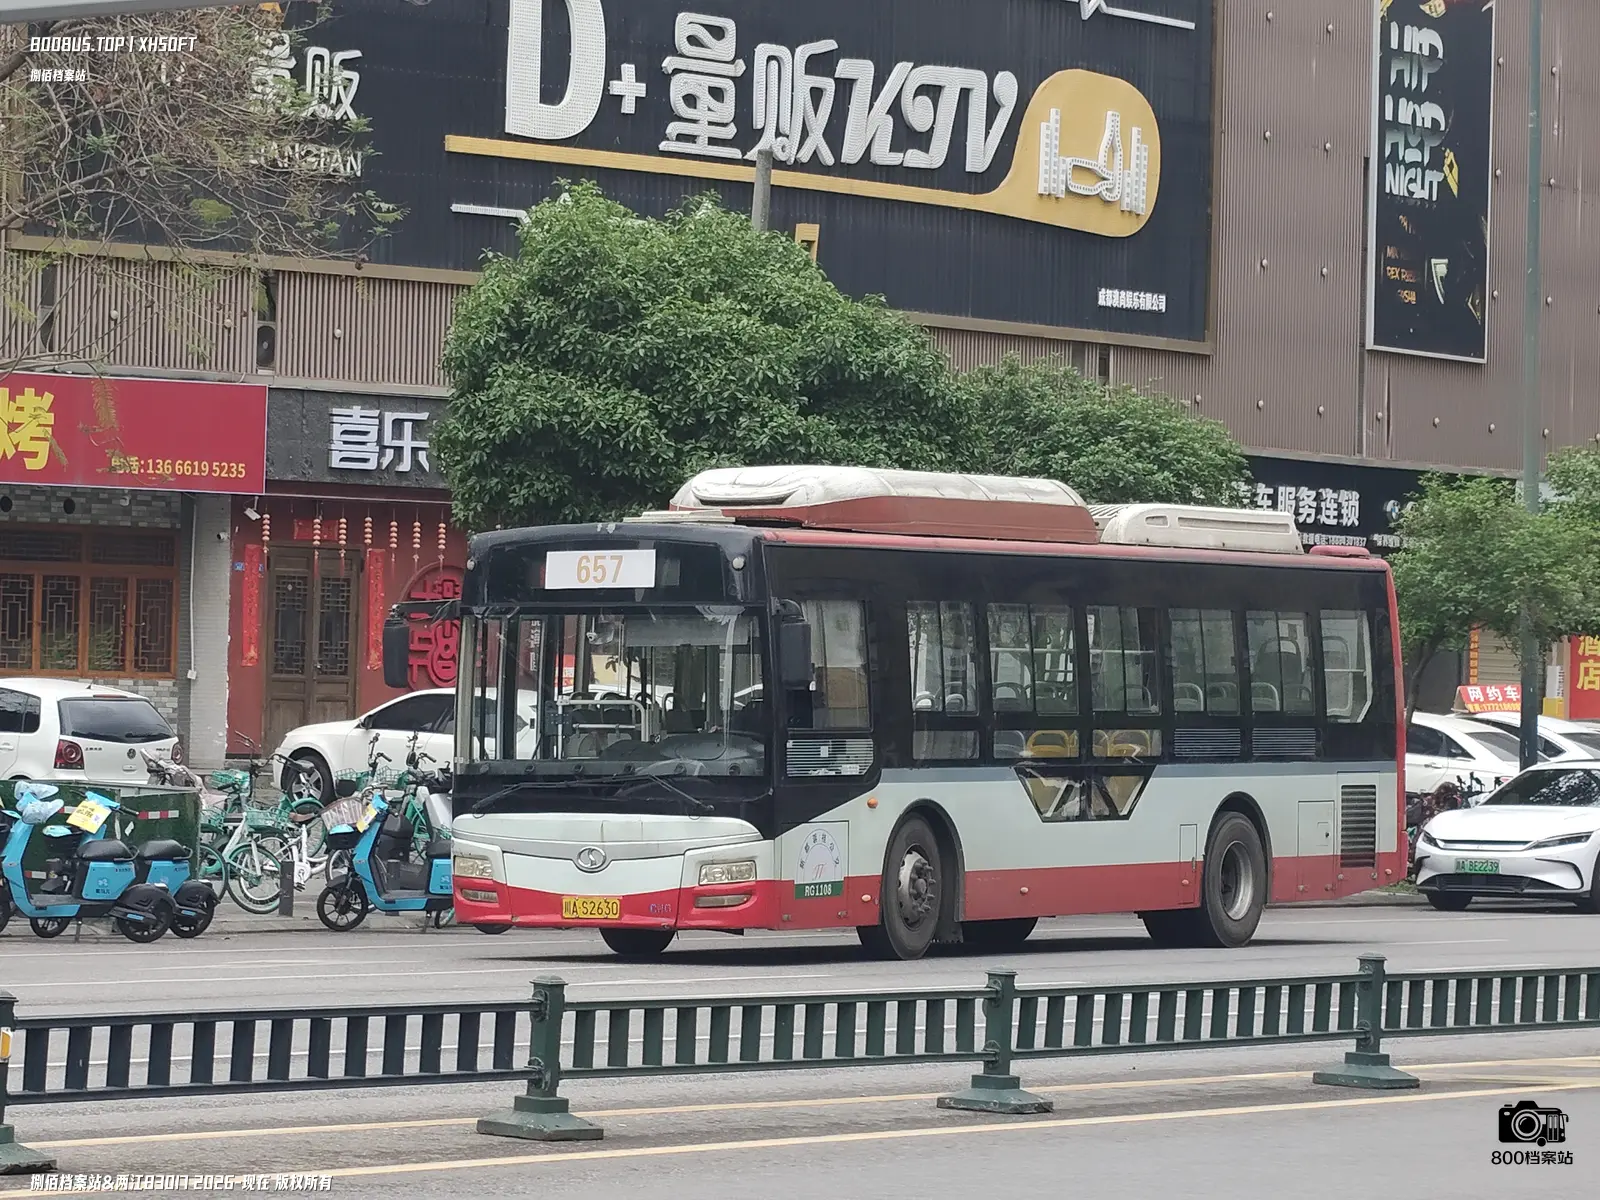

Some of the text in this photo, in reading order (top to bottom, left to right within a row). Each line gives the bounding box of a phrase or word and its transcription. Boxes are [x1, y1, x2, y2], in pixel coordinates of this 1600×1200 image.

[1385, 162, 1445, 201] NIGHT
[0, 387, 55, 470] 烤
[329, 405, 430, 472] 喜乐
[175, 460, 209, 477] 6619
[212, 462, 246, 478] 5235
[576, 555, 623, 584] 657
[1467, 685, 1520, 702] 网约车
[804, 883, 832, 897] RG1108
